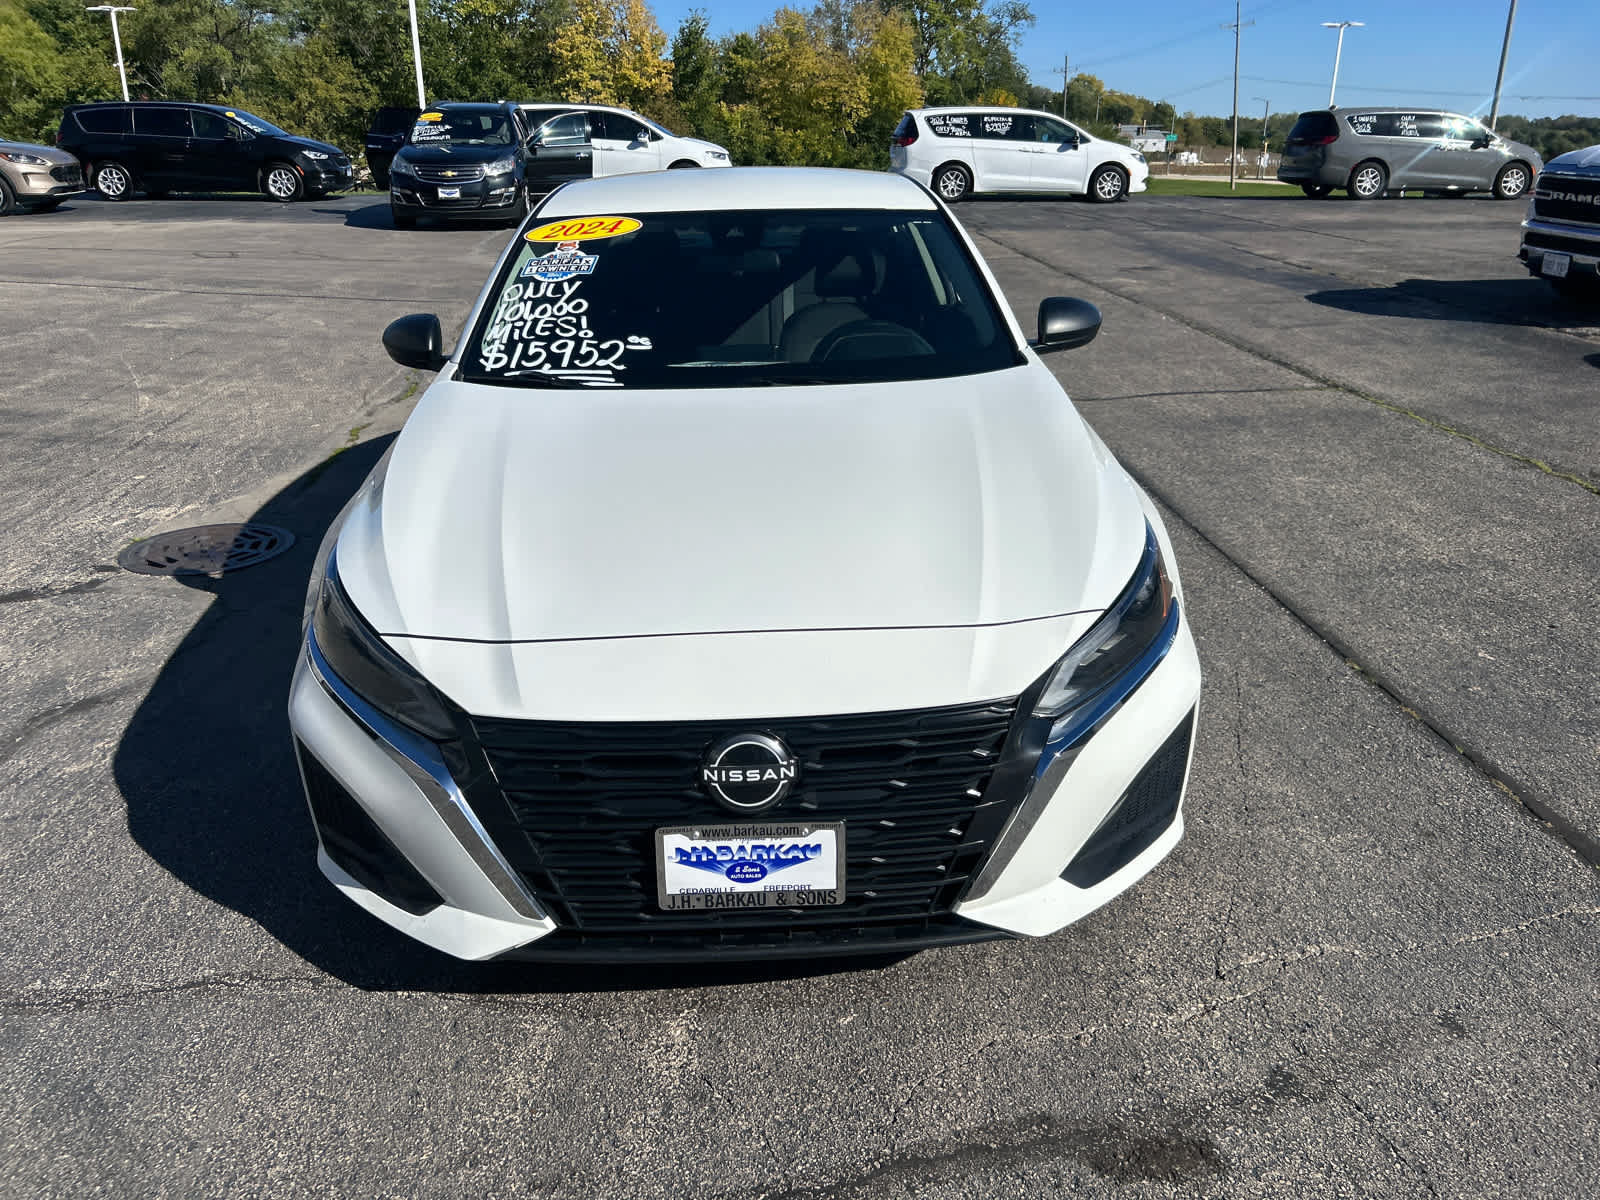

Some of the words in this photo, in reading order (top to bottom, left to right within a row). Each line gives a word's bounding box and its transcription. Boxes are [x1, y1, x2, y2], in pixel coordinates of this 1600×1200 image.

[1553, 191, 1592, 204] RAM
[542, 219, 625, 239] 2024
[530, 257, 593, 266] CARFAX
[537, 264, 590, 272] OWNER
[503, 281, 582, 301] ONLY
[703, 765, 795, 782] NISSAN
[701, 825, 800, 838] www.barkau.com
[742, 865, 760, 873] Sons
[679, 886, 736, 895] CEDARVILLE
[763, 884, 813, 892] FREEPORT
[705, 891, 767, 908] BARKAU
[776, 892, 787, 906] &
[797, 890, 837, 906] SONS
